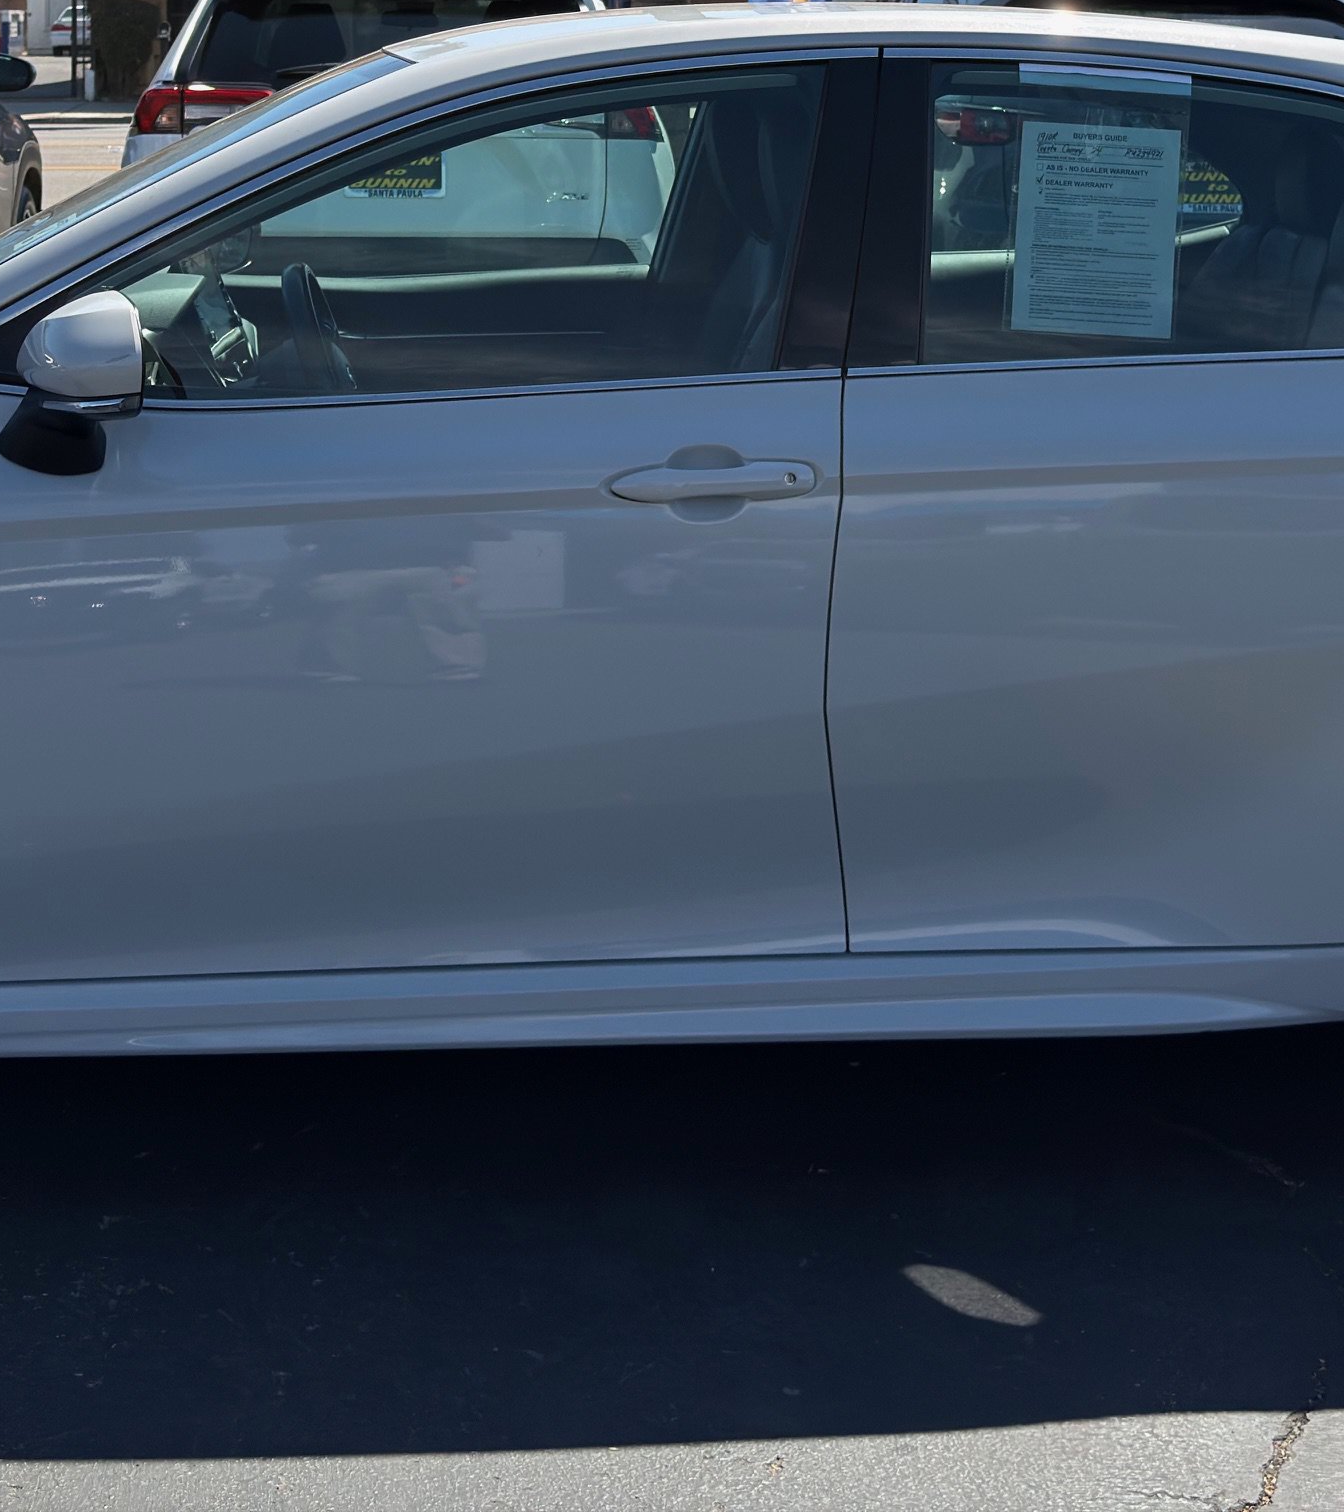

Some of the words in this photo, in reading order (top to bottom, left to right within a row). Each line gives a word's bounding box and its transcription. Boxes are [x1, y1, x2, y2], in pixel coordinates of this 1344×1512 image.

[1104, 134, 1128, 142] GUIDE
[1080, 166, 1108, 174] DEALER
[1109, 168, 1149, 177] WARRANTY
[1074, 181, 1114, 189] WARRANTY
